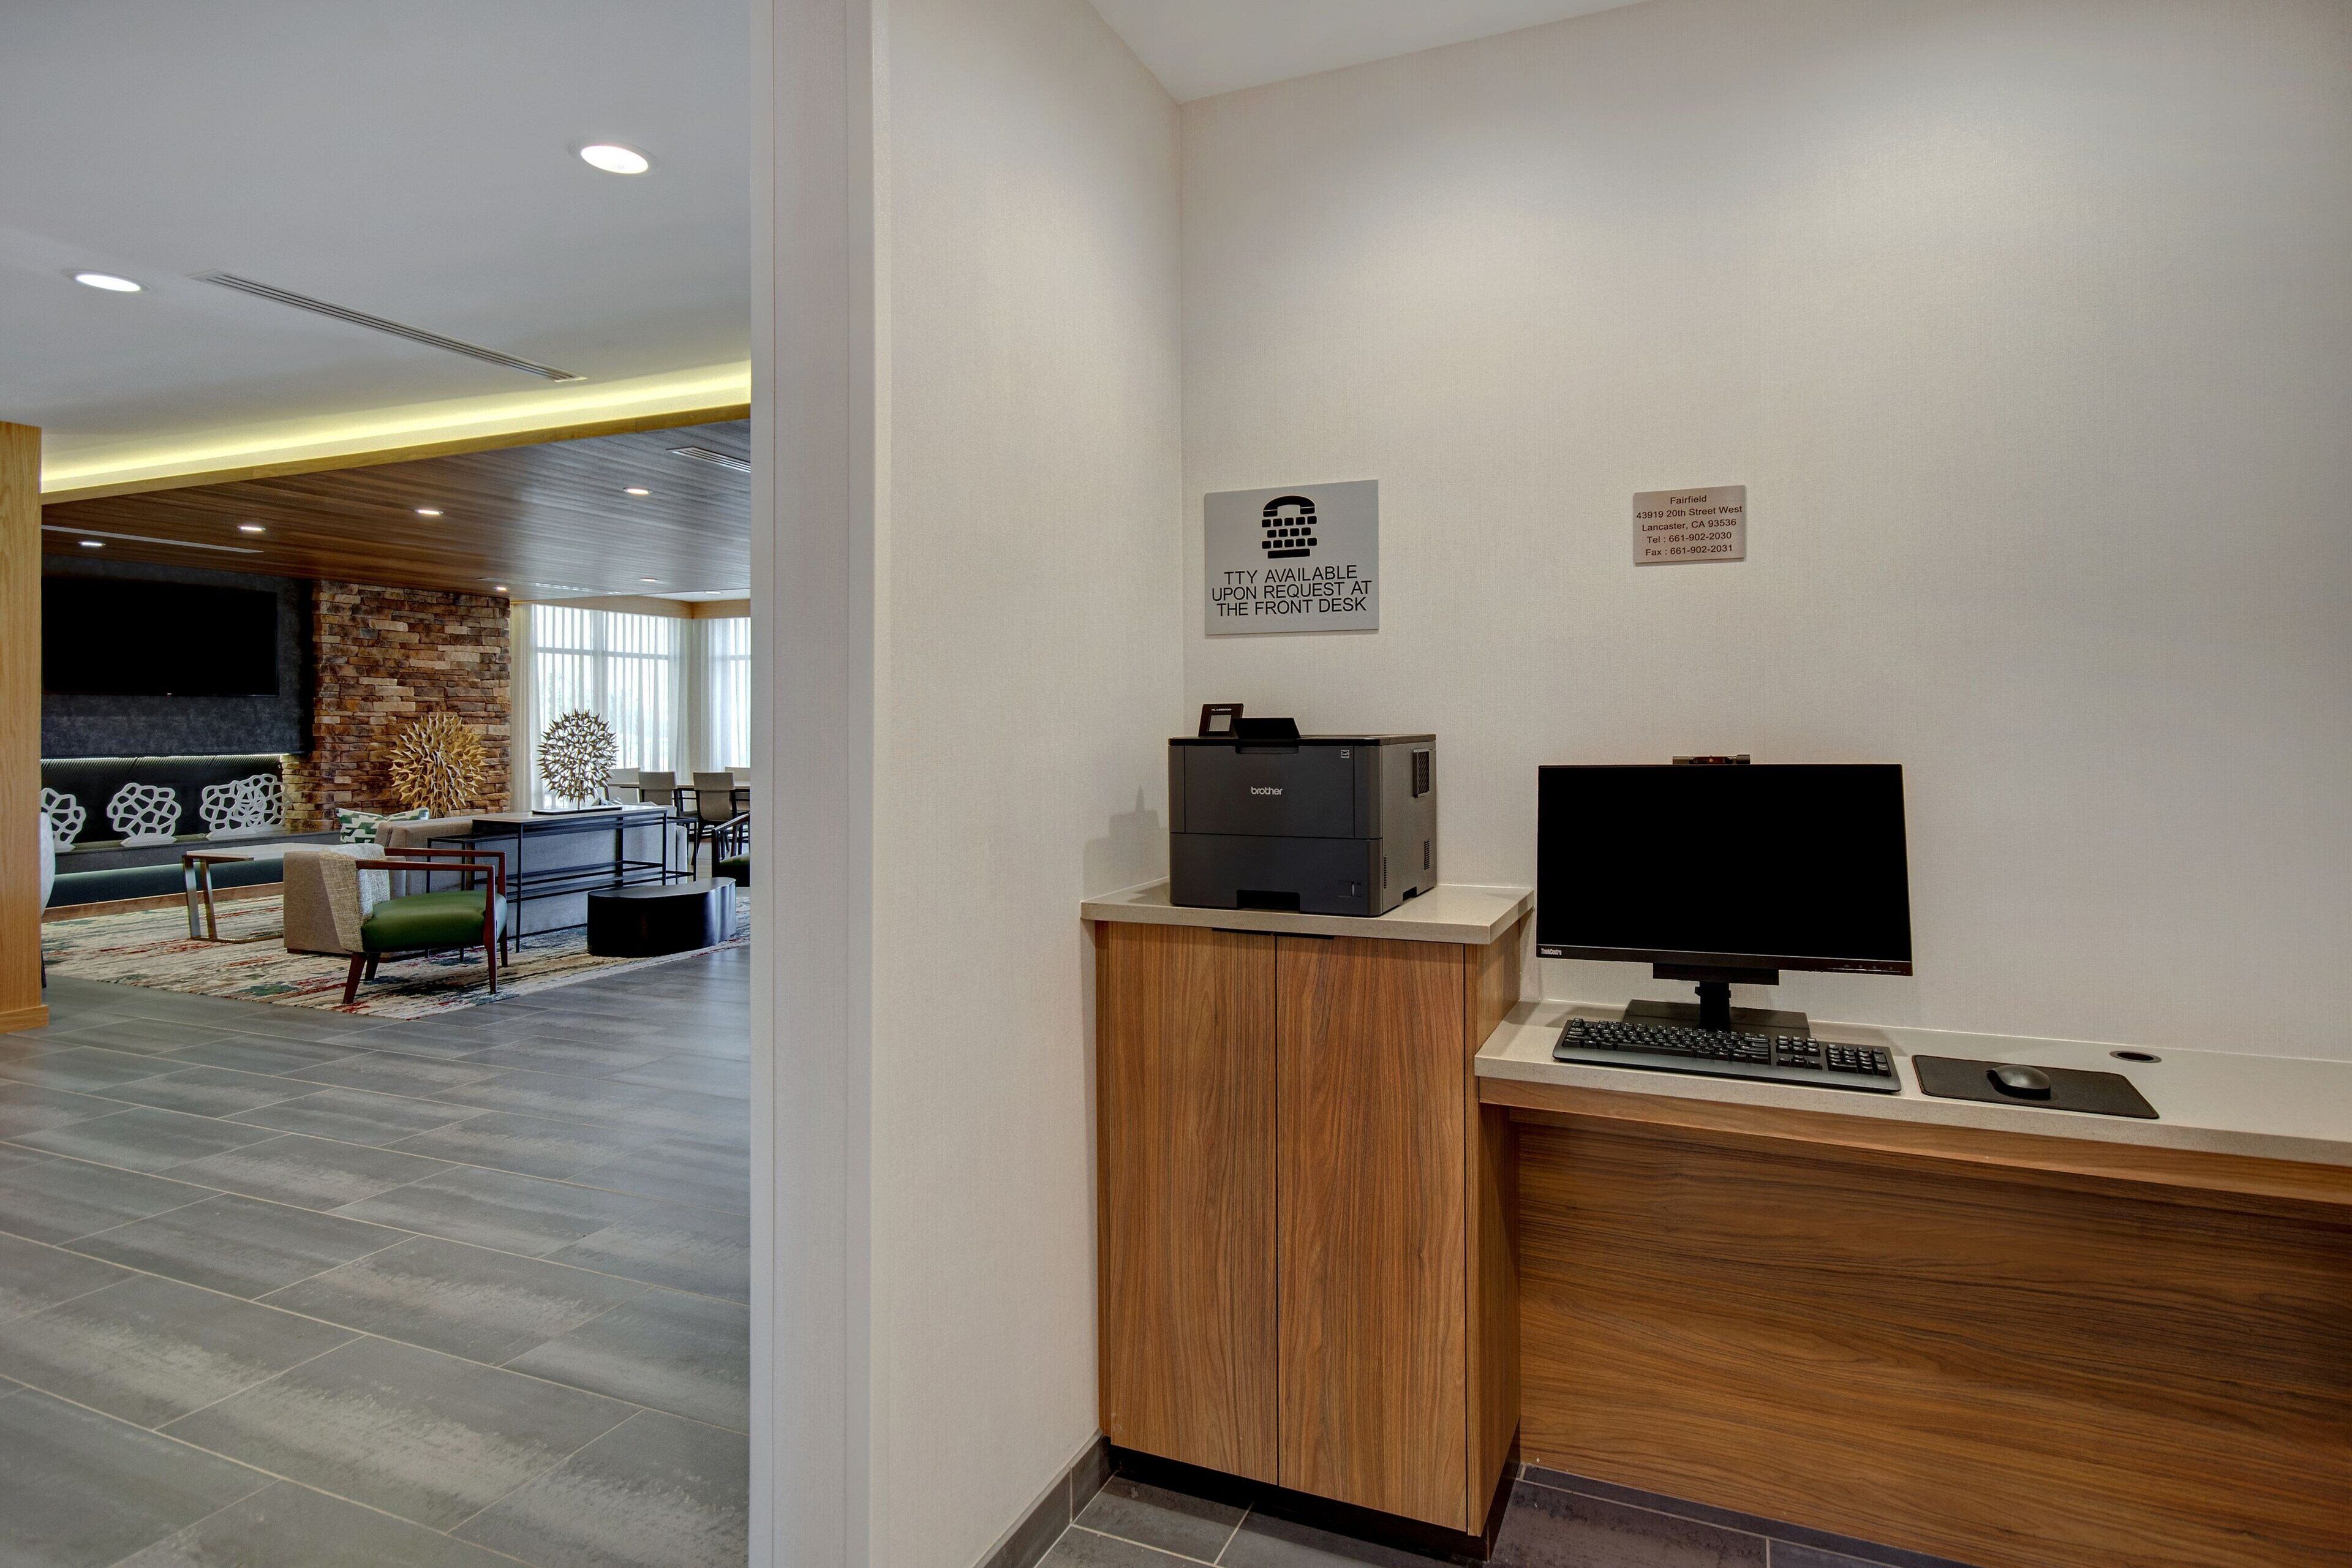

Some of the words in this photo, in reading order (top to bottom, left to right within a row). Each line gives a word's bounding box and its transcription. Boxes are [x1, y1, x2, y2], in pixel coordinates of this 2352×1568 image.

[1670, 496, 1706, 504] Fairfield
[1642, 522, 1688, 531] Lancaster,
[1669, 532, 1732, 542] 661-902-2030
[1670, 545, 1732, 554] 661-902-2031
[1224, 570, 1258, 585] TTY
[1265, 565, 1357, 583] AVAILABLE
[1212, 587, 1256, 601] UPON
[1264, 582, 1344, 599] REQUEST
[1351, 581, 1372, 595] AT
[1216, 602, 1248, 616] THE
[1256, 600, 1313, 615] FRONT
[1319, 597, 1366, 612] DESK
[1251, 786, 1283, 795] brother
